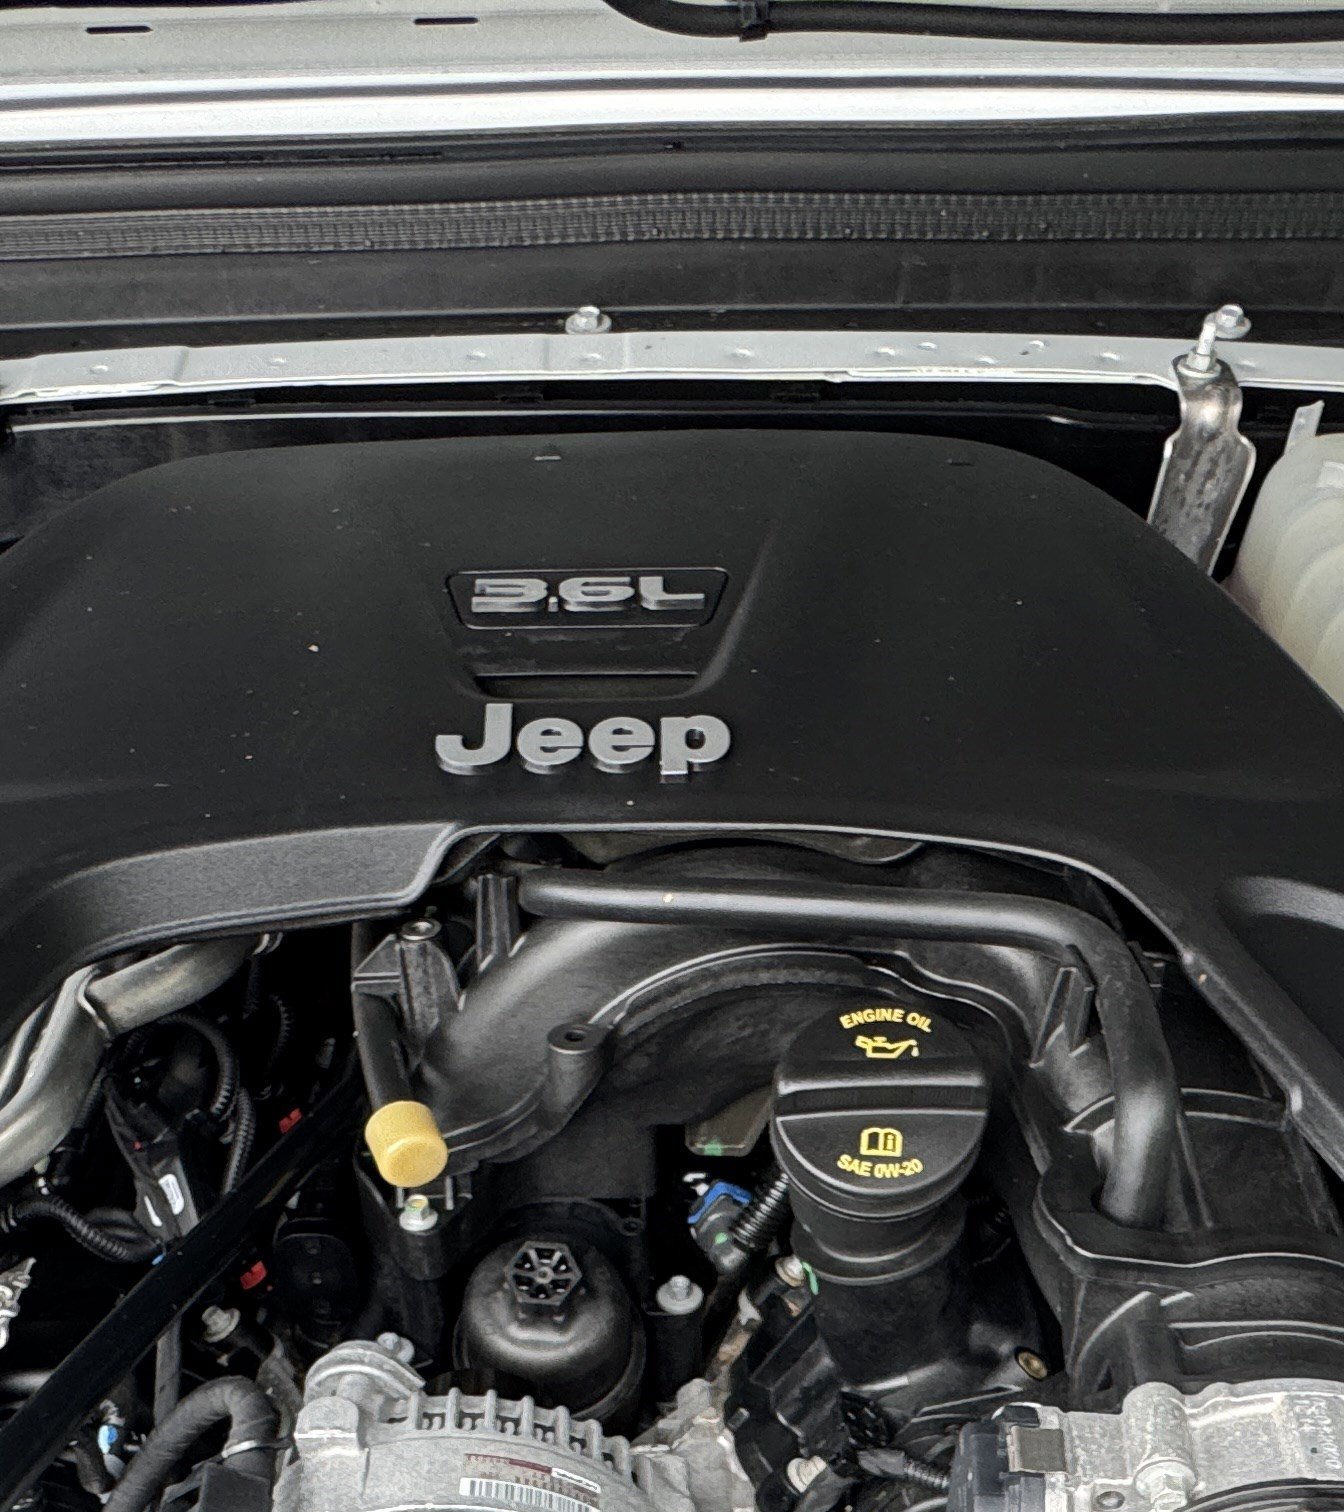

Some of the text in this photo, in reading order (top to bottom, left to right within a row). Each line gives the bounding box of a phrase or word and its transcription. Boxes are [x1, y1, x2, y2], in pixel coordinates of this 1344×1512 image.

[471, 576, 705, 613] 3.6L
[435, 703, 731, 784] Jeep
[839, 1009, 932, 1032] ENGINE OIL
[837, 1155, 923, 1179] SAE 0W-20
